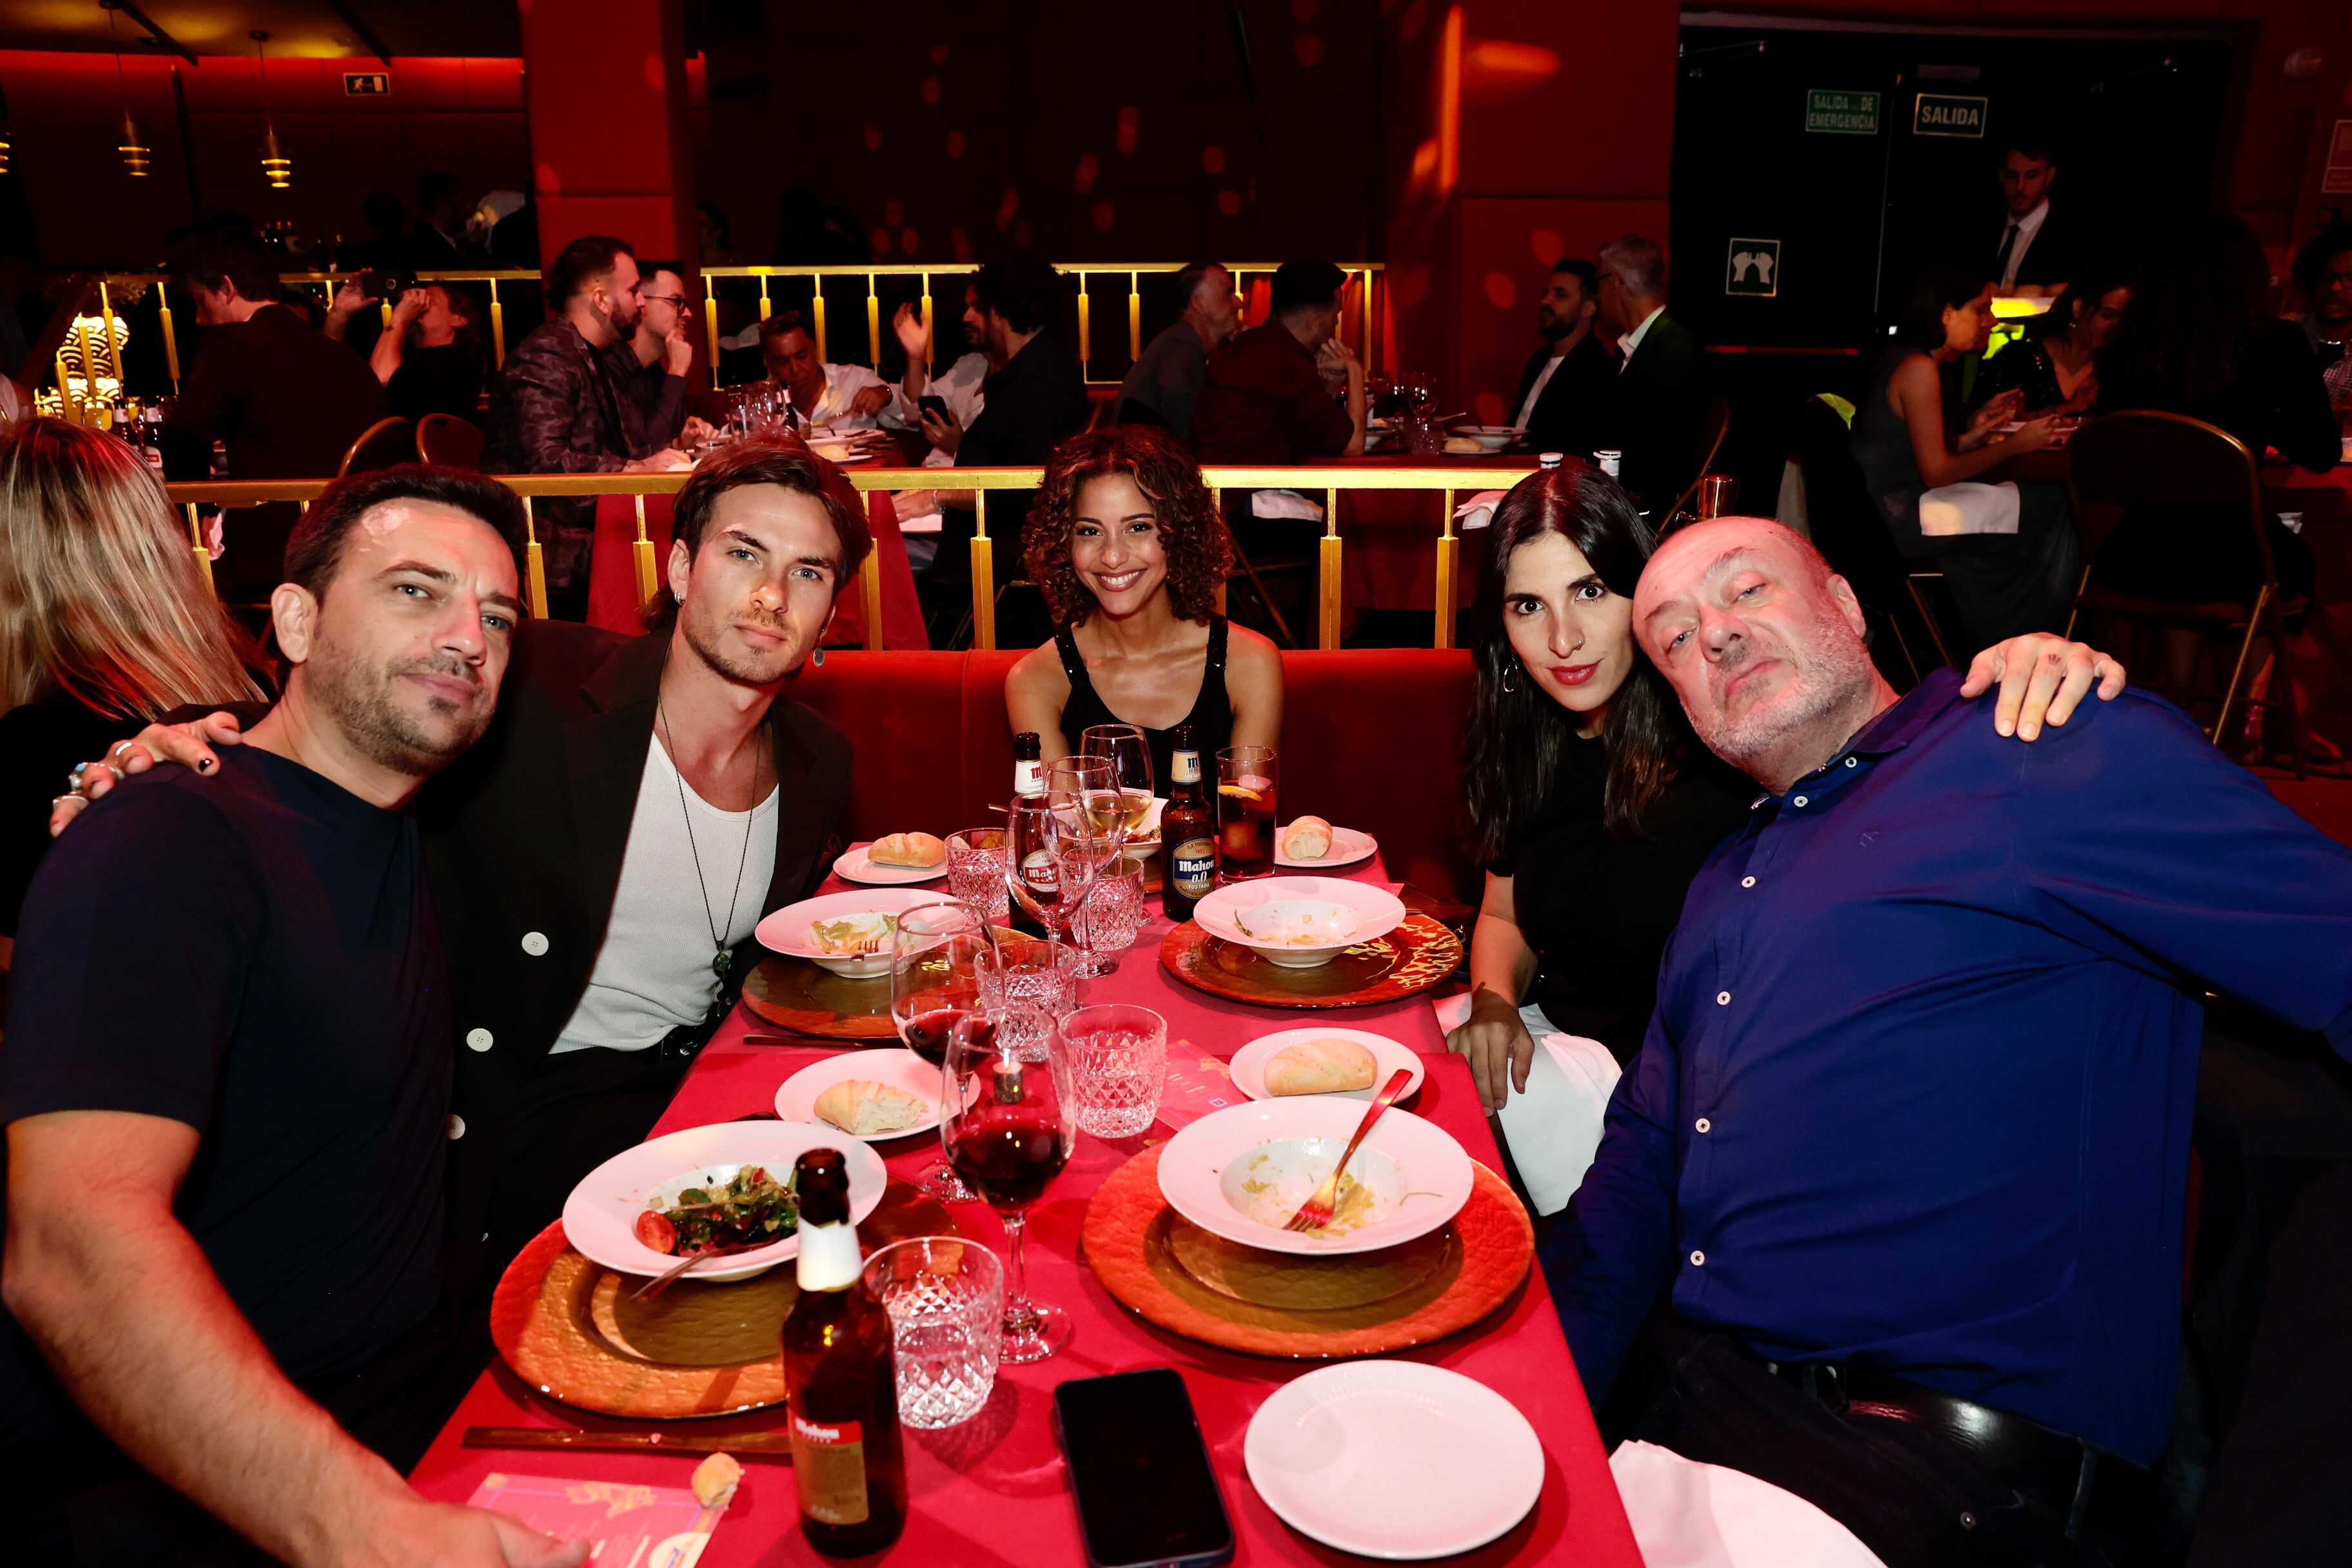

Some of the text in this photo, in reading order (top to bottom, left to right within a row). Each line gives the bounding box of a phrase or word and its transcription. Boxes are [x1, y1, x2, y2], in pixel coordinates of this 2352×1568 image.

[1814, 95, 1874, 111] SALIDA DE
[1809, 113, 1875, 129] EMERGENCIA
[1921, 105, 1979, 126] SALIDA
